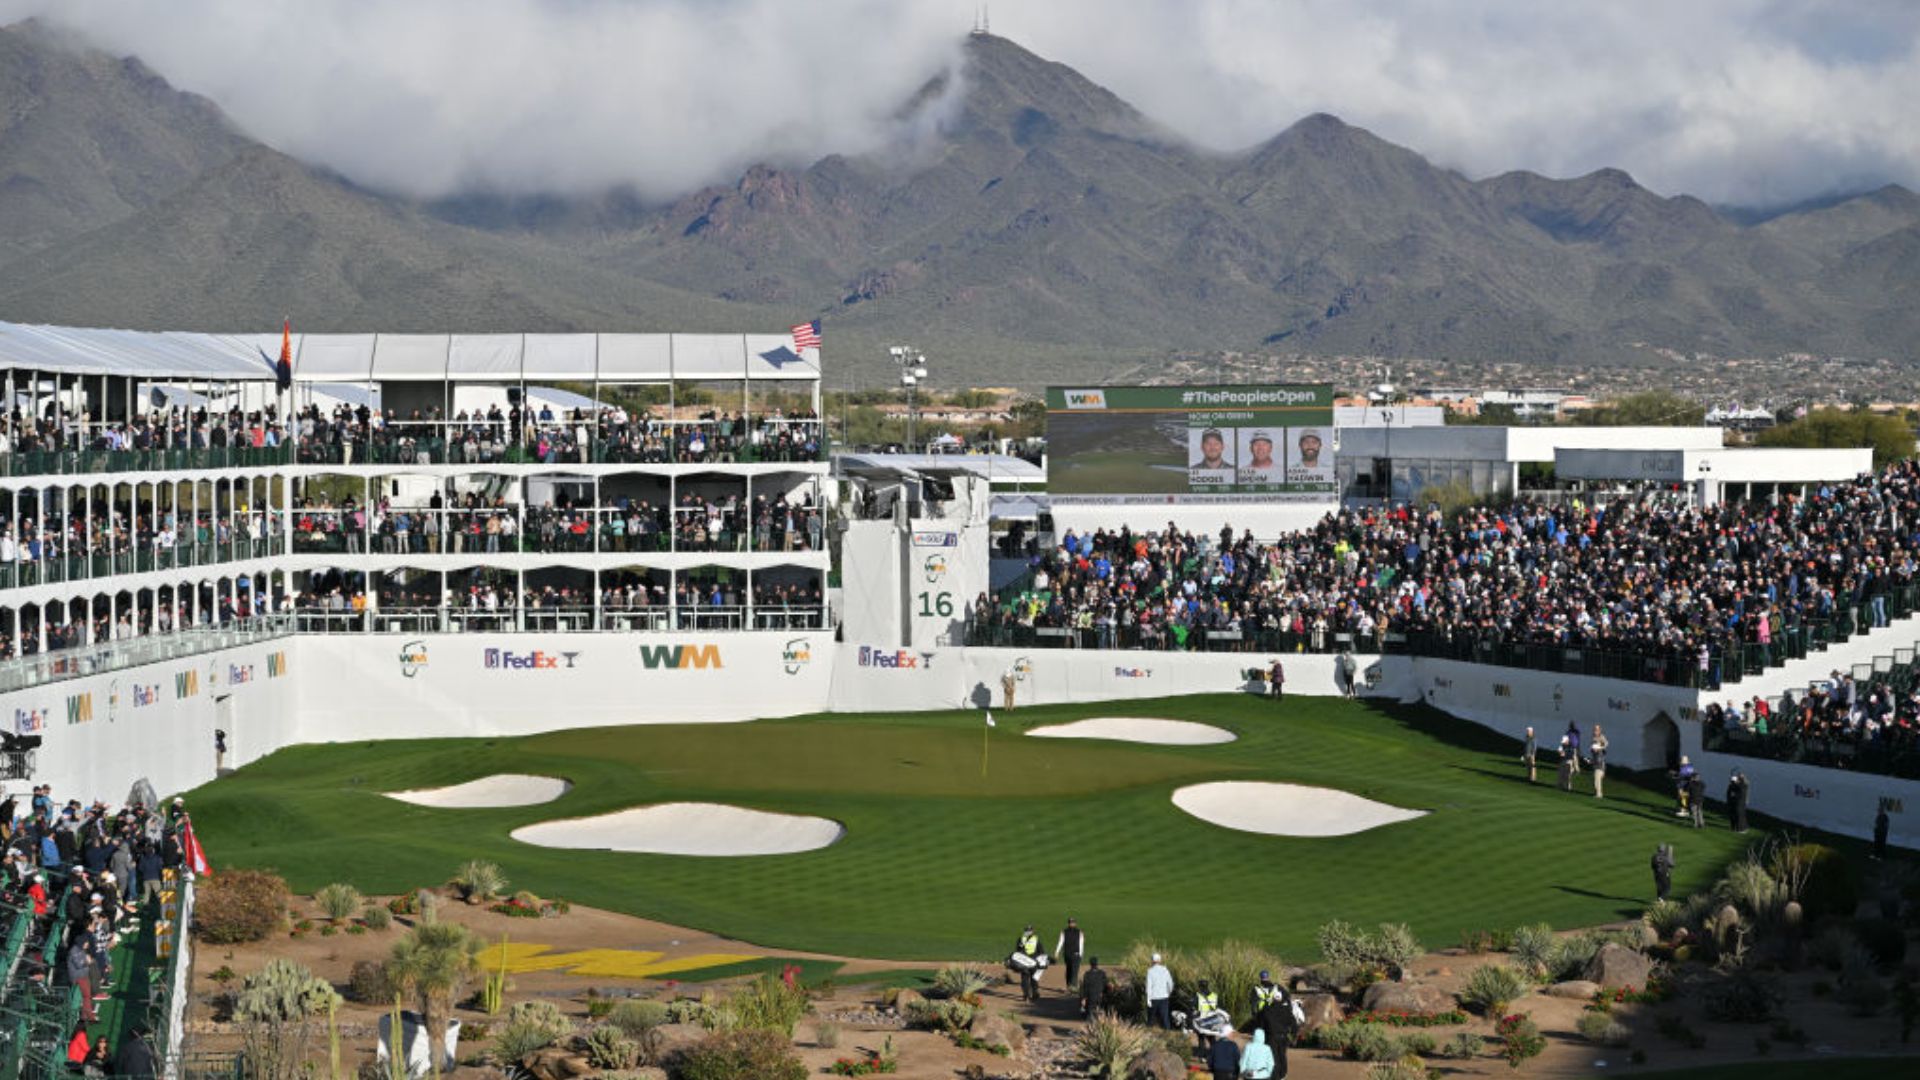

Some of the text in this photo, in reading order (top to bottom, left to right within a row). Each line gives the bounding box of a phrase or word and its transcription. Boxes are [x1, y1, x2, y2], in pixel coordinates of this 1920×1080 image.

[1071, 395, 1099, 404] WM
[1182, 389, 1316, 406] #ThePeoplesOpen
[918, 591, 953, 617] 16
[503, 650, 557, 668] FedEx
[640, 644, 722, 669] WM
[873, 649, 916, 669] FedEx
[175, 669, 198, 698] WM
[67, 690, 93, 724] WM
